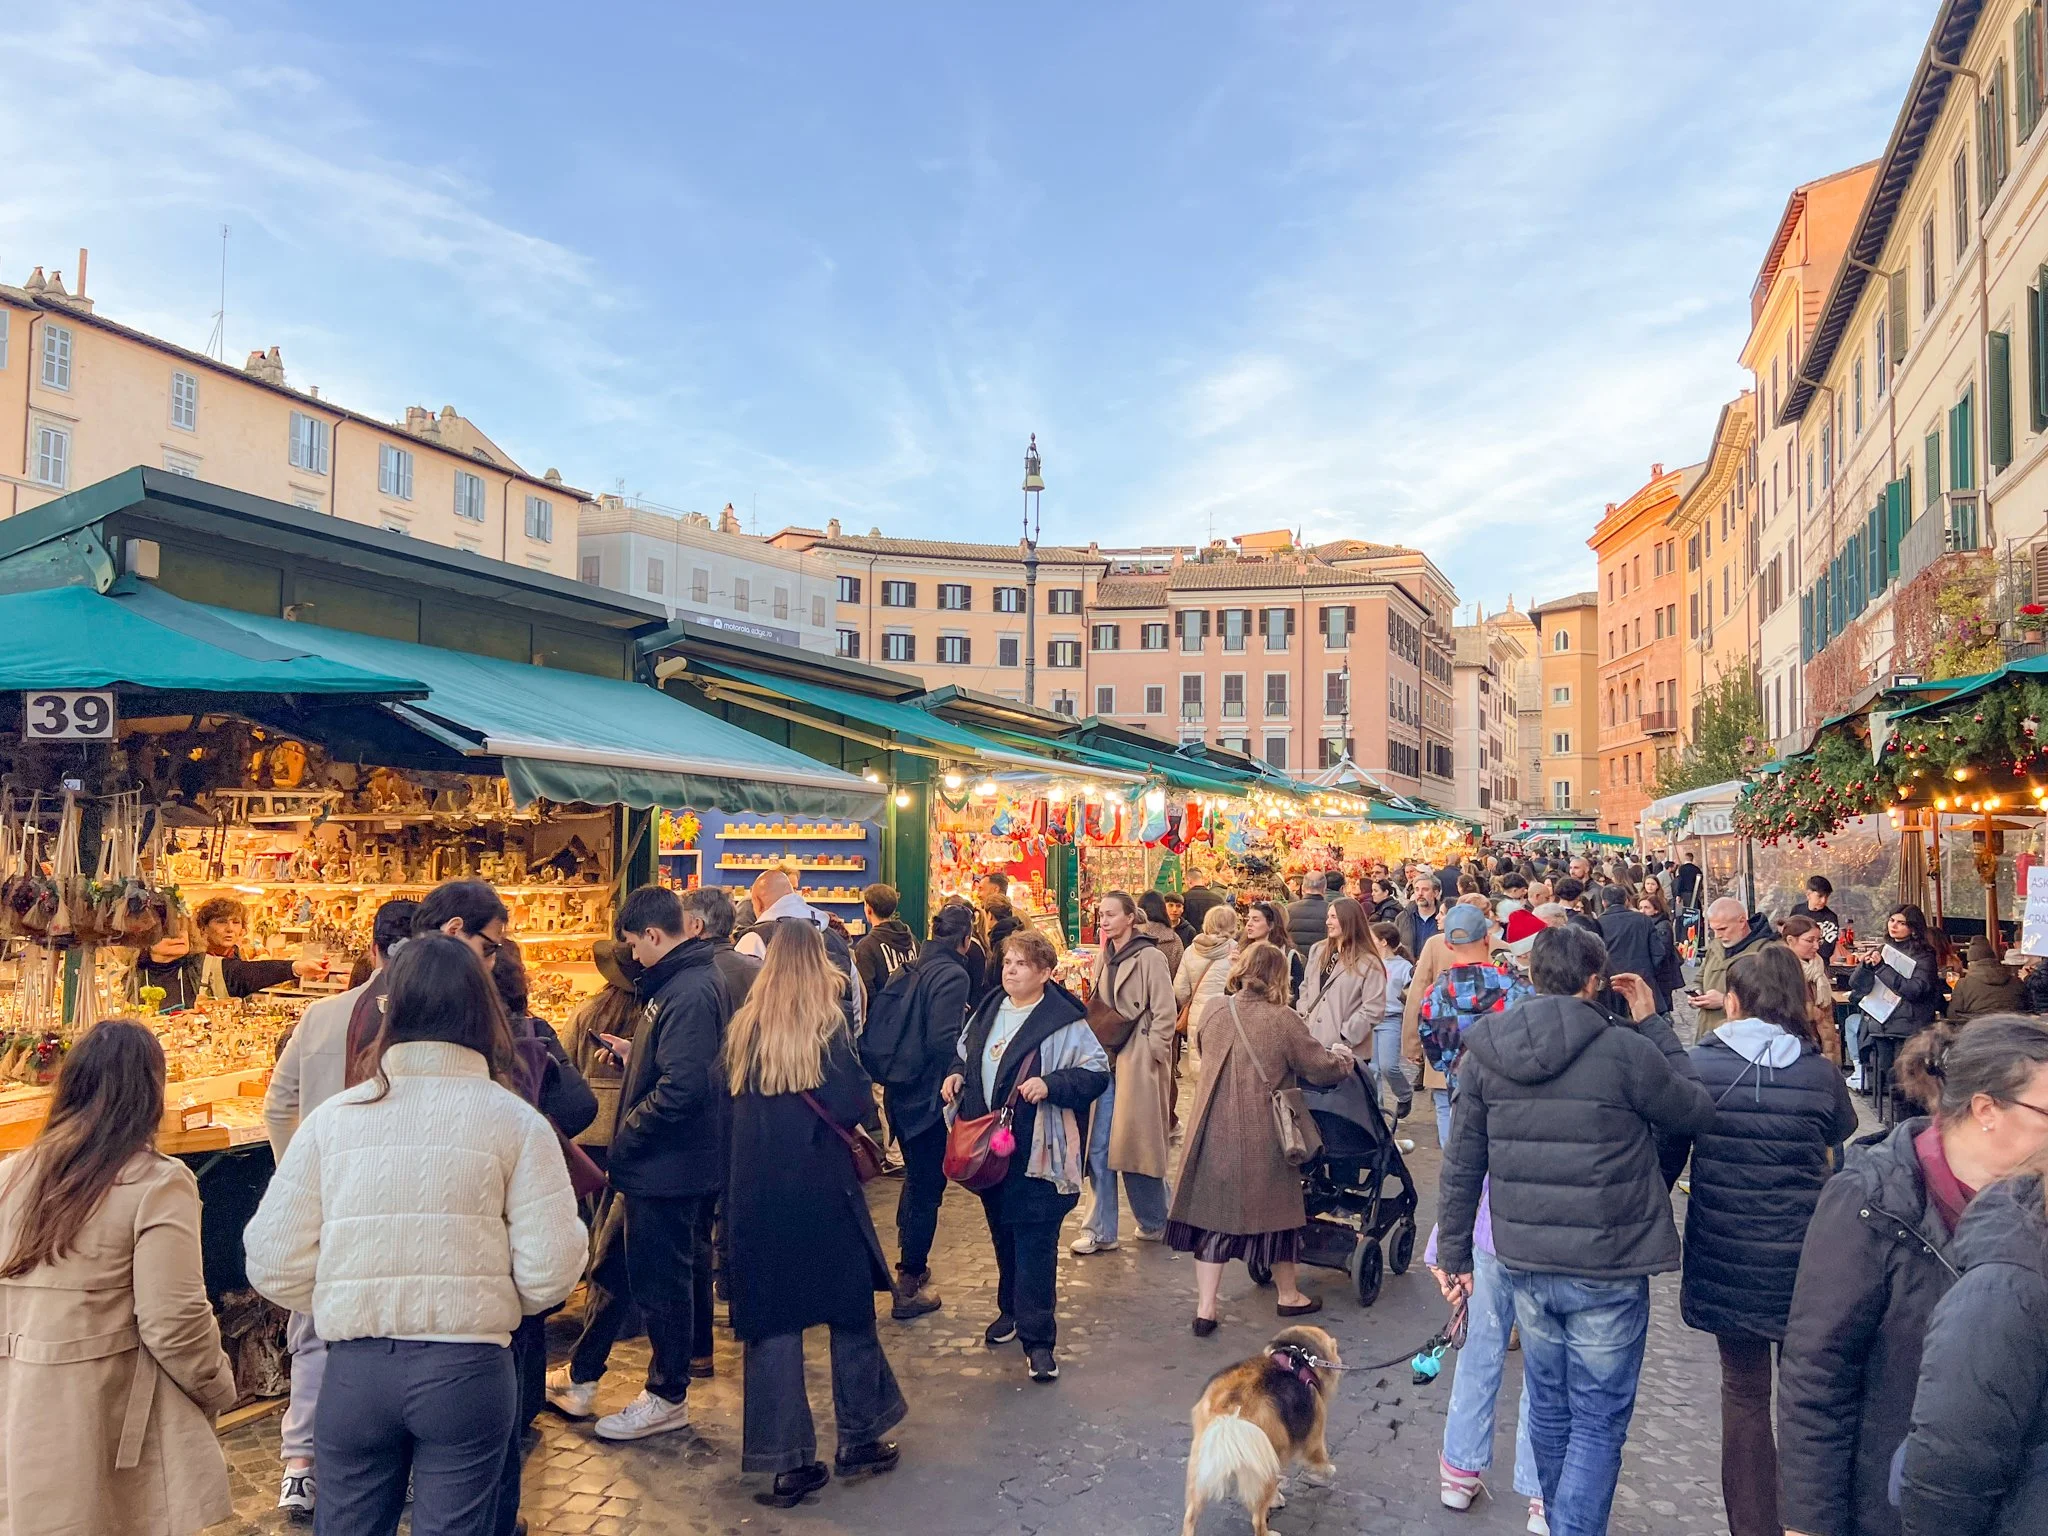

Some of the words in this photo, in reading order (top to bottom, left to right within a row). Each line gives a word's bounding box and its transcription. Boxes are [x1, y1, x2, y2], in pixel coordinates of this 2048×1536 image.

[723, 622, 750, 634] motorola
[751, 627, 766, 638] edge
[32, 695, 110, 735] 39
[1697, 813, 1733, 833] RO
